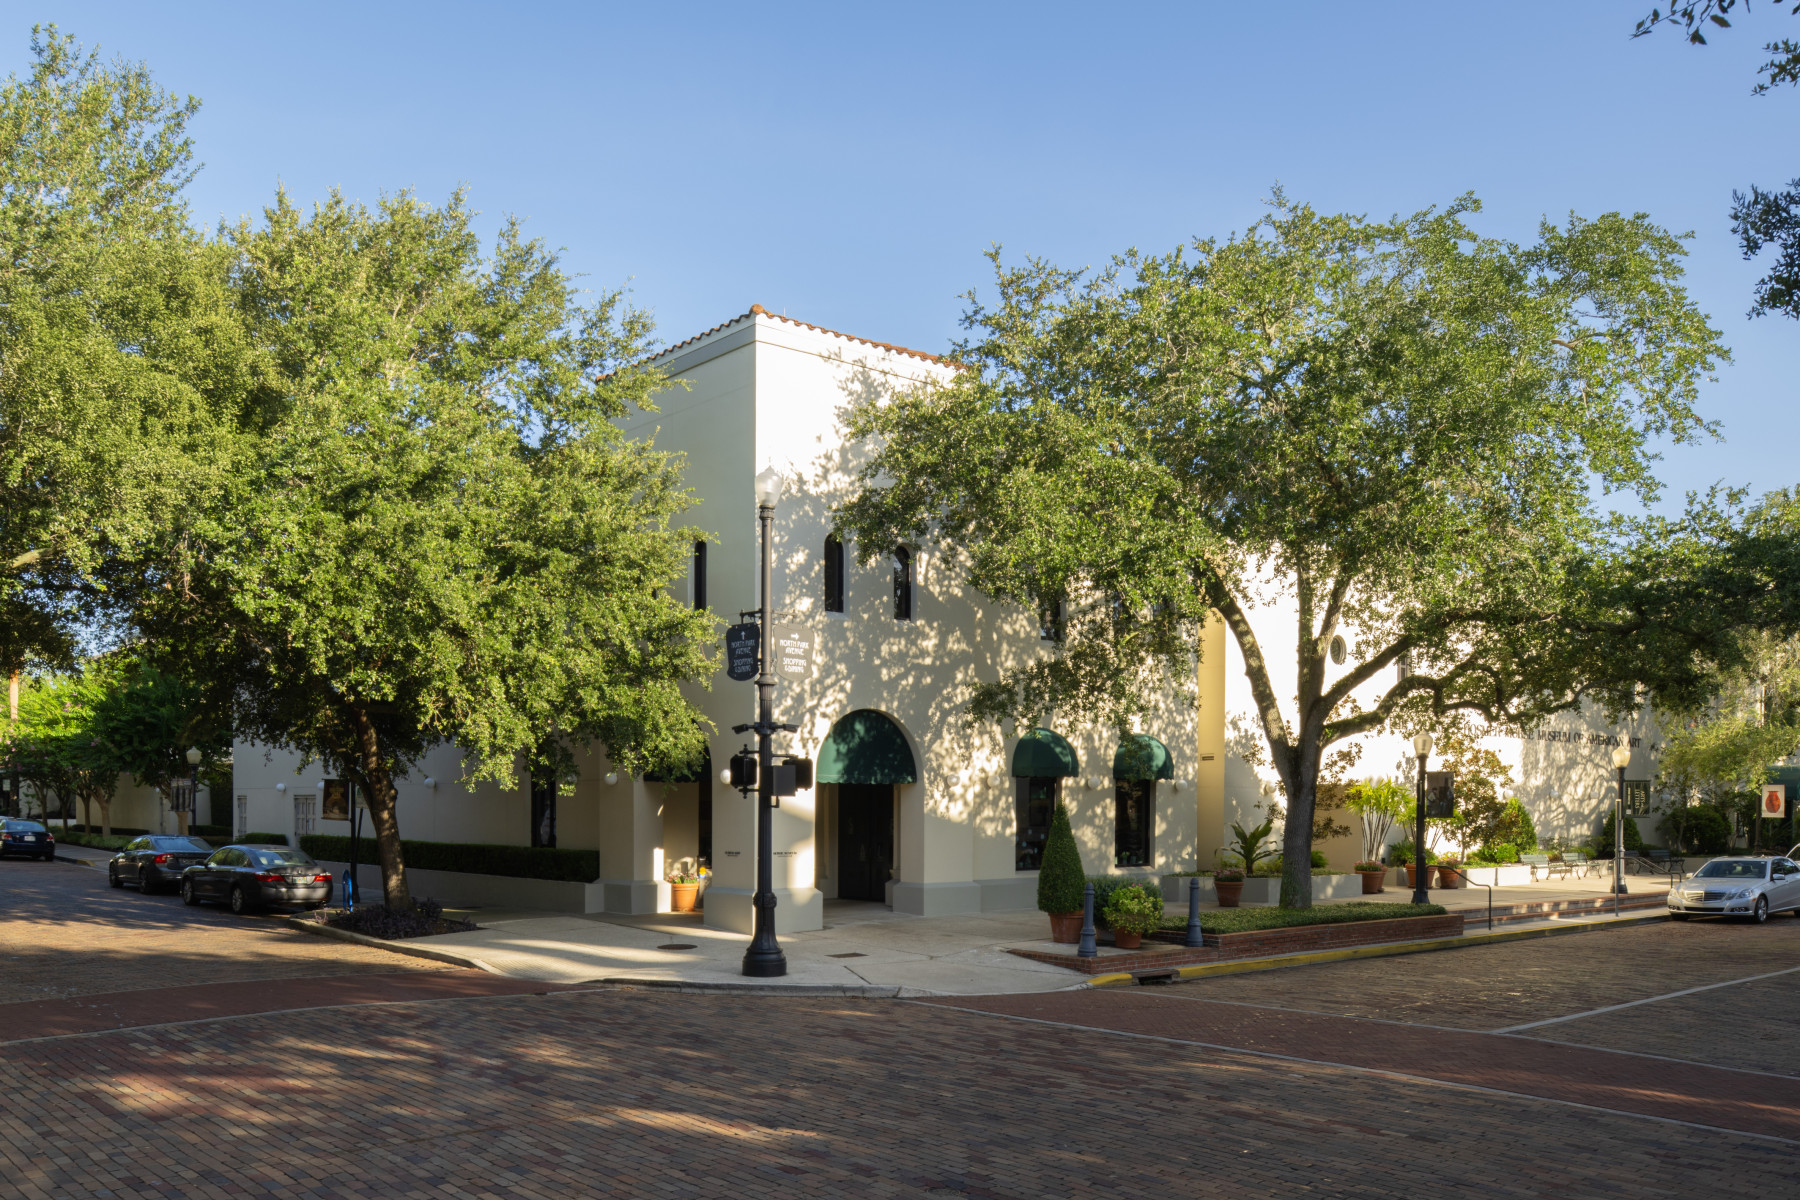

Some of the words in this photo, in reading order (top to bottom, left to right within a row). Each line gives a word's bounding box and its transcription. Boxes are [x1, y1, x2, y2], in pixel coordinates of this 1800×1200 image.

[780, 639, 796, 648] NORTH
[797, 641, 809, 649] PARK
[785, 647, 804, 655] AVENUE
[733, 658, 754, 666] SHOPPING
[783, 657, 807, 667] SHOPPING
[1537, 730, 1571, 742] MUSEUM
[1574, 732, 1583, 743] OF
[1586, 734, 1624, 746] AMERICAN
[1628, 737, 1641, 748] ART
